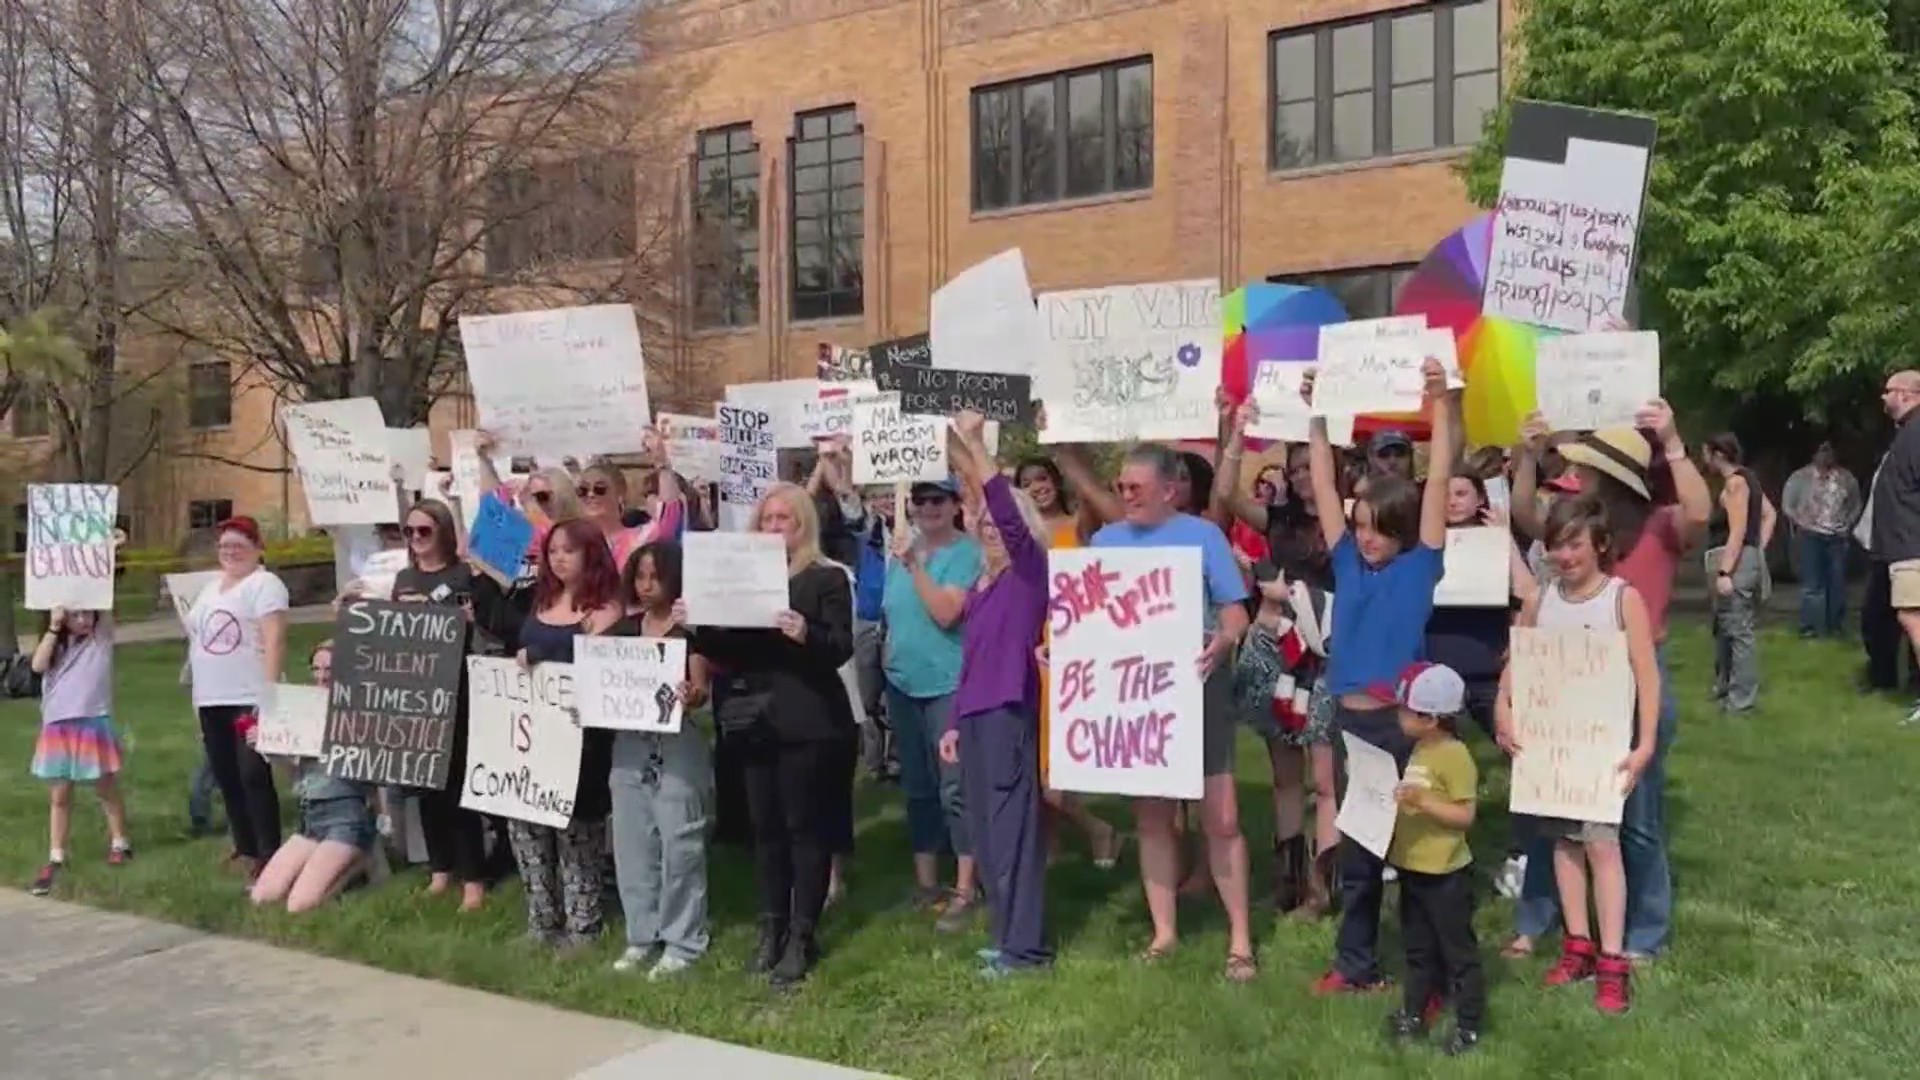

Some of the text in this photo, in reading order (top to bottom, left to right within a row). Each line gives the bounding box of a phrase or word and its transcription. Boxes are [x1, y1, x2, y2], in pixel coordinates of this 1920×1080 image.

[1049, 294, 1112, 341] MY
[917, 369, 947, 388] NO
[956, 372, 1008, 391] ROOM
[719, 406, 769, 430] STOP
[905, 392, 941, 409] FOR
[951, 394, 1019, 418] RACISM
[861, 424, 938, 447] RACISM
[869, 444, 941, 467] WRONG
[347, 601, 457, 644] STAYING
[353, 644, 441, 678] SILENT
[471, 657, 574, 708] SILENCE
[331, 680, 455, 716] IN TIMES OF
[1058, 654, 1175, 713] BE THE
[328, 708, 451, 752] INJUSTICE
[509, 710, 532, 753] IS
[1065, 709, 1177, 769] CHANGE
[326, 743, 443, 790] PRIVILEGE
[469, 761, 573, 818] COMPLIANCE
